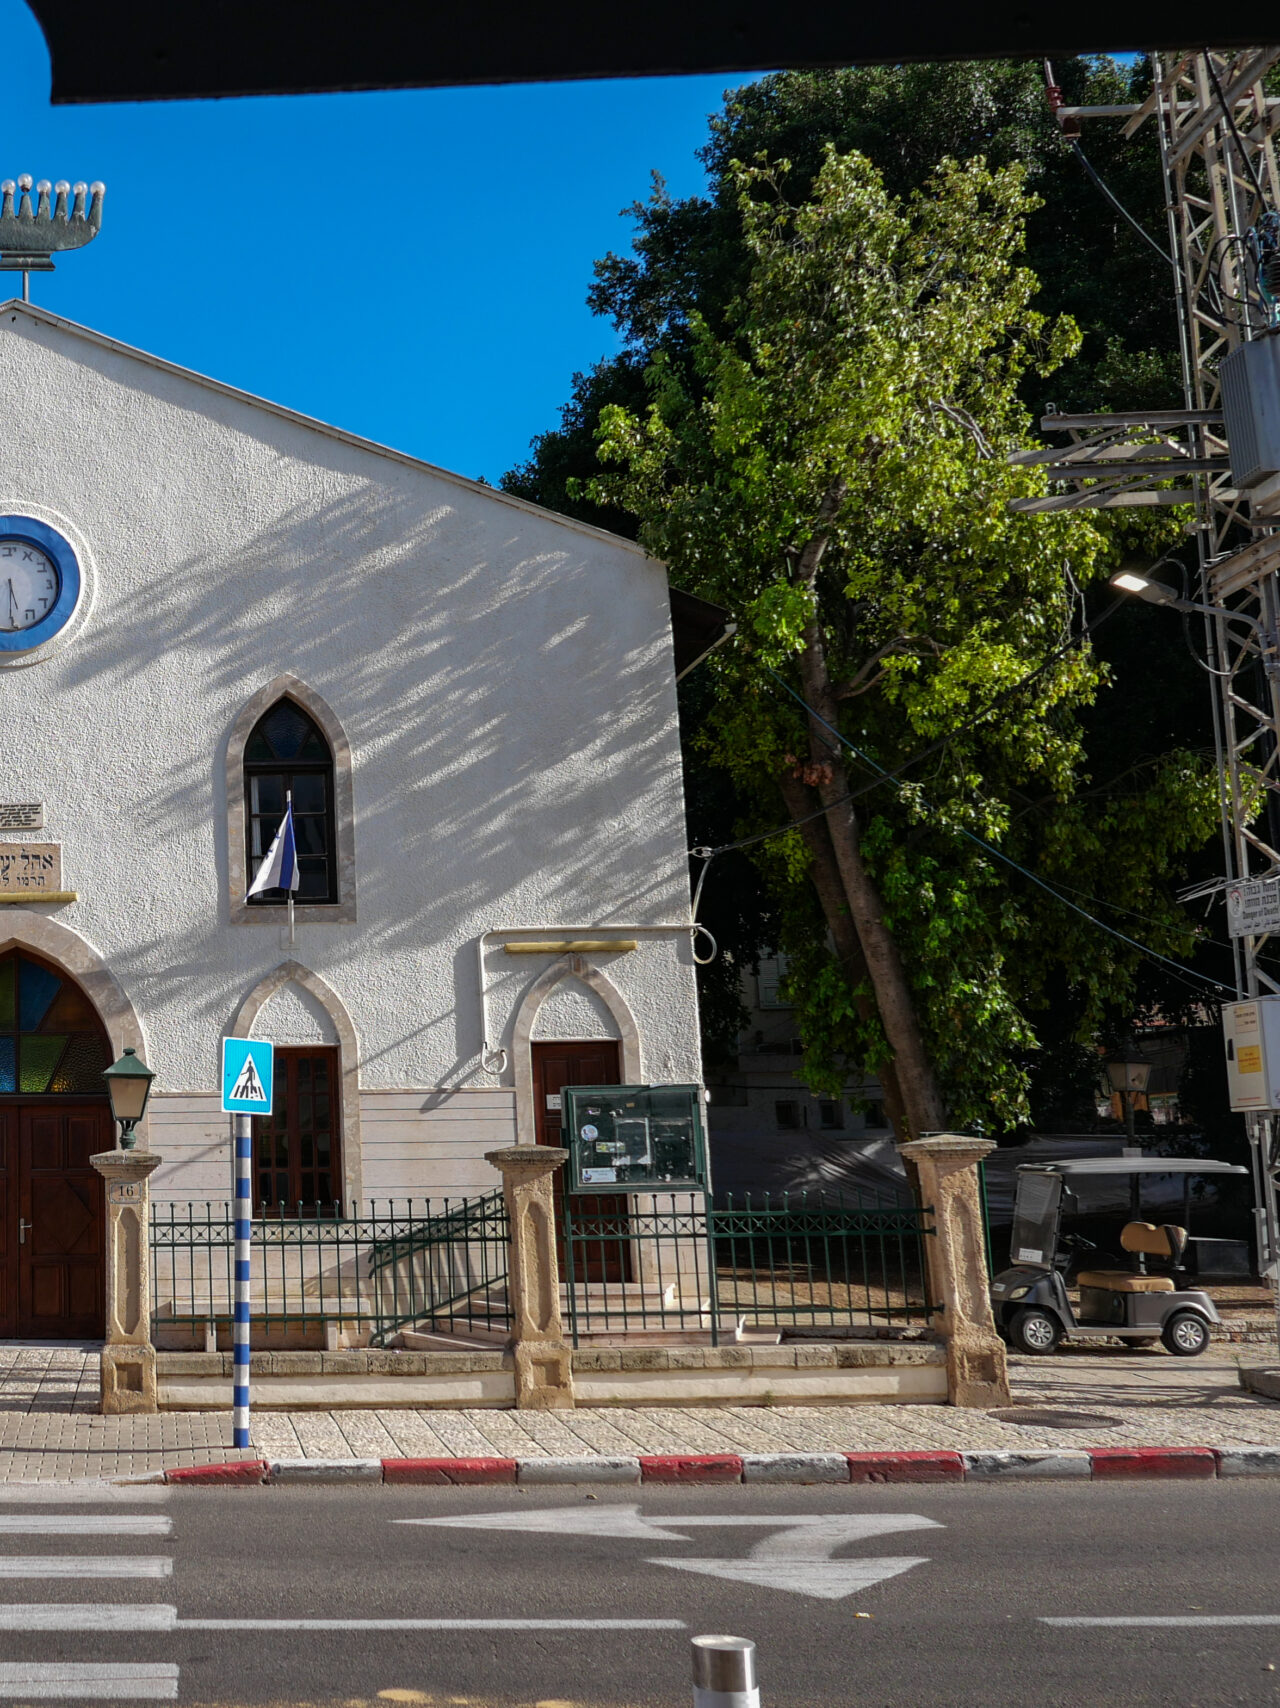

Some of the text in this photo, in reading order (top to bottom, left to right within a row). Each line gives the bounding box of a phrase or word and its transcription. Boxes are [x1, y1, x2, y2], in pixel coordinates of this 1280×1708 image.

[3, 548, 17, 556] יב
[23, 552, 33, 562] א
[37, 563, 47, 572] ב
[47, 580, 53, 590] ג
[38, 598, 48, 608] ד
[25, 610, 36, 620] ה
[20, 848, 54, 870] אהל
[120, 1186, 133, 1196] 16
